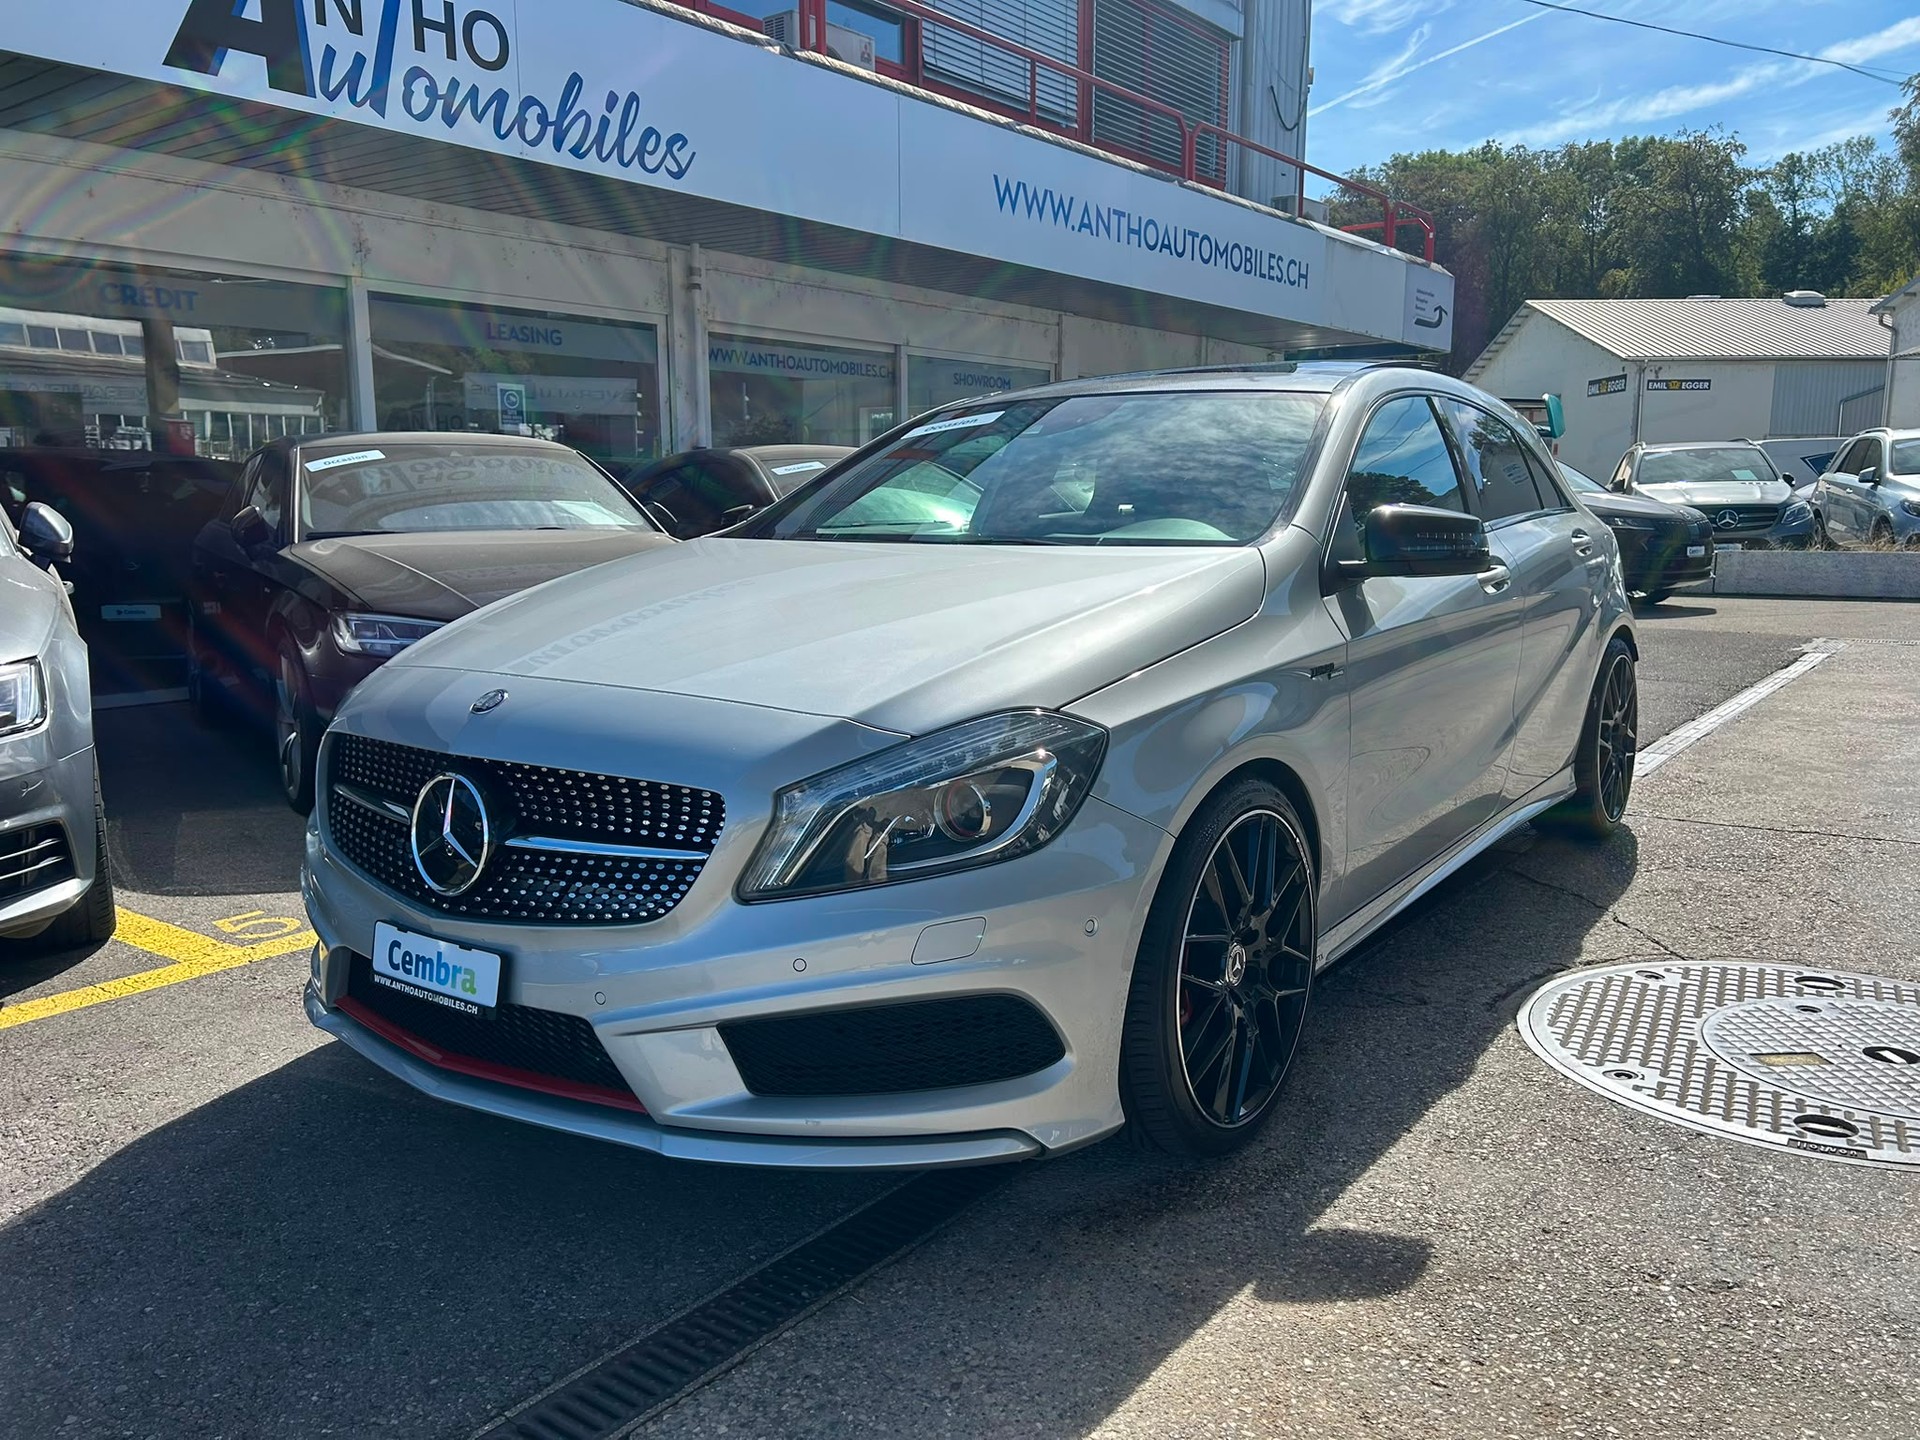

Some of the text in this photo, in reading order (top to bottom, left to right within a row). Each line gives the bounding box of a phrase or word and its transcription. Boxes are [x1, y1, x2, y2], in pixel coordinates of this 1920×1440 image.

[992, 174, 1309, 290] WWW.ANTHOAUTOMOBILES.CH
[487, 322, 563, 346] LEASING
[708, 346, 894, 380] WWW.ANTHOAUTOMOBILES.CH
[953, 372, 1012, 391] SHOWROOM
[1647, 381, 1710, 390] EMIL EGGER
[212, 910, 302, 939] 5
[387, 940, 477, 995] Cembra
[374, 974, 478, 1015] WWW.ANTHOAUTOMOBILES.CH
